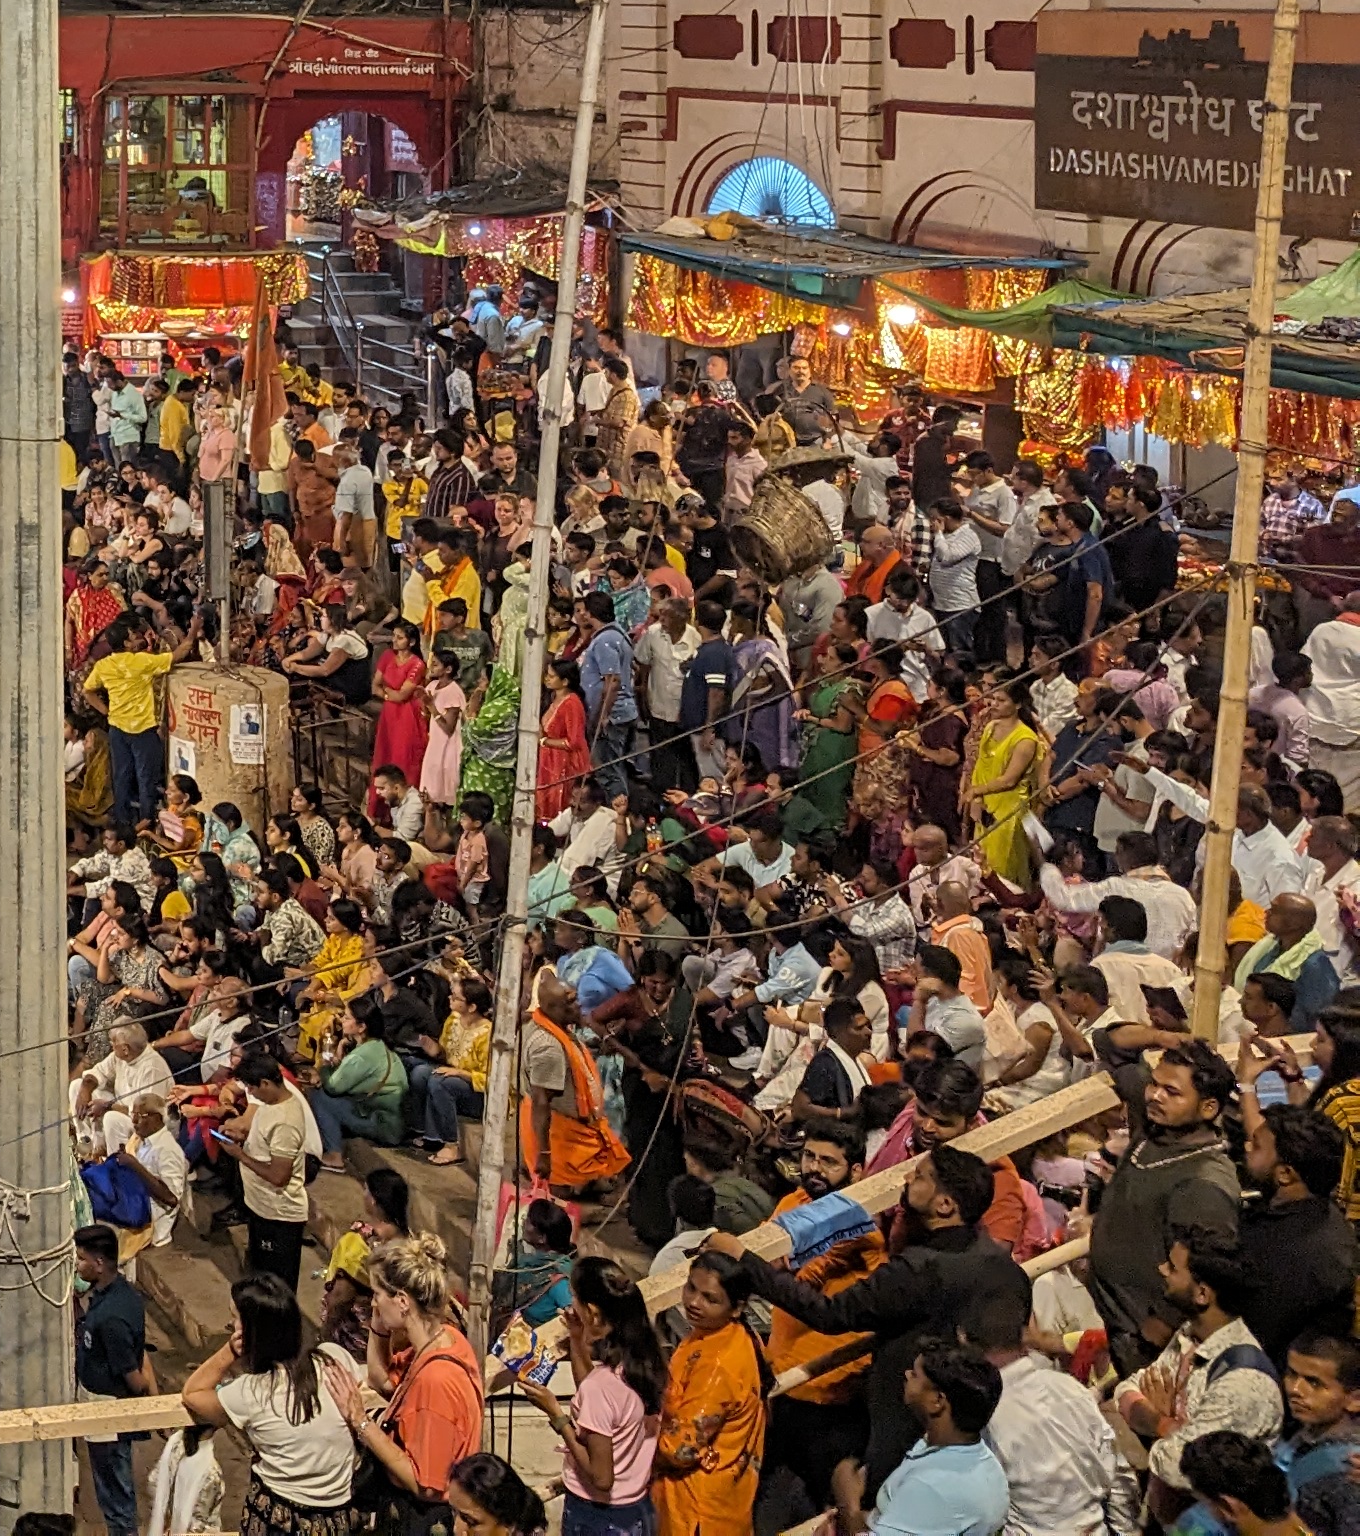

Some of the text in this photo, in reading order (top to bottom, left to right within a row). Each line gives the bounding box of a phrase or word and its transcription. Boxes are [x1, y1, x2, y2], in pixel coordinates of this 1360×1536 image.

[1070, 81, 1323, 144] दशाश्वमेध घट
[1049, 147, 1353, 197] DASHASHVAMEDH GHAT
[187, 686, 213, 708] राम
[185, 721, 220, 747] राम
